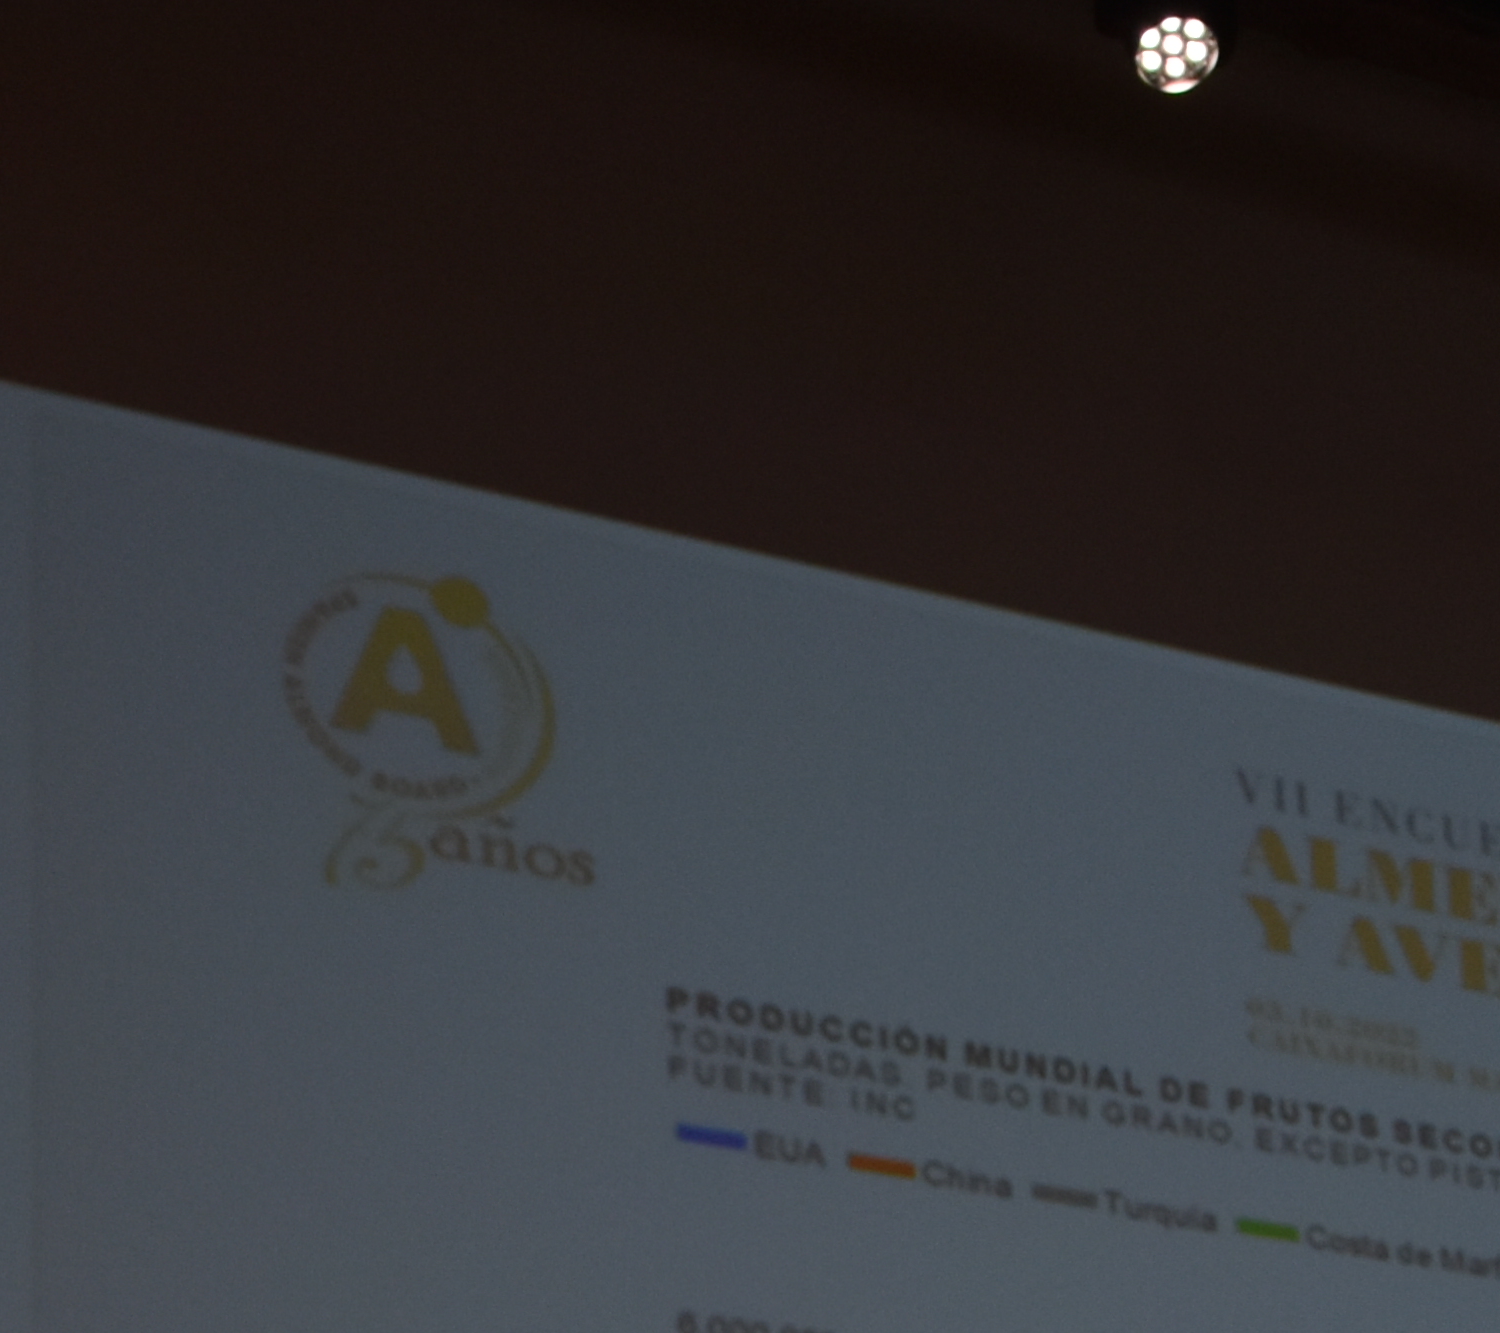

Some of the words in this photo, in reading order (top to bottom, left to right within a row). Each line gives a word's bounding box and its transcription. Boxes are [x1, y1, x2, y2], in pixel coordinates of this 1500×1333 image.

[1235, 767, 1309, 818] VII
[430, 815, 596, 887] años
[1243, 893, 1304, 953] Y
[666, 987, 948, 1061] PRODUCCIÓN
[964, 1040, 1143, 1098] MUNDIAL
[1160, 1076, 1209, 1110] DE
[1228, 1089, 1379, 1138] FRUTOS
[852, 1089, 916, 1121] INC
[926, 1068, 1029, 1111] PESO
[1042, 1089, 1090, 1119] EN
[1255, 1126, 1418, 1178] EXCEPTO
[753, 1133, 826, 1169] EUA
[923, 1160, 1012, 1199] China
[1307, 1225, 1390, 1262] Costa
[1397, 1241, 1432, 1268] de
